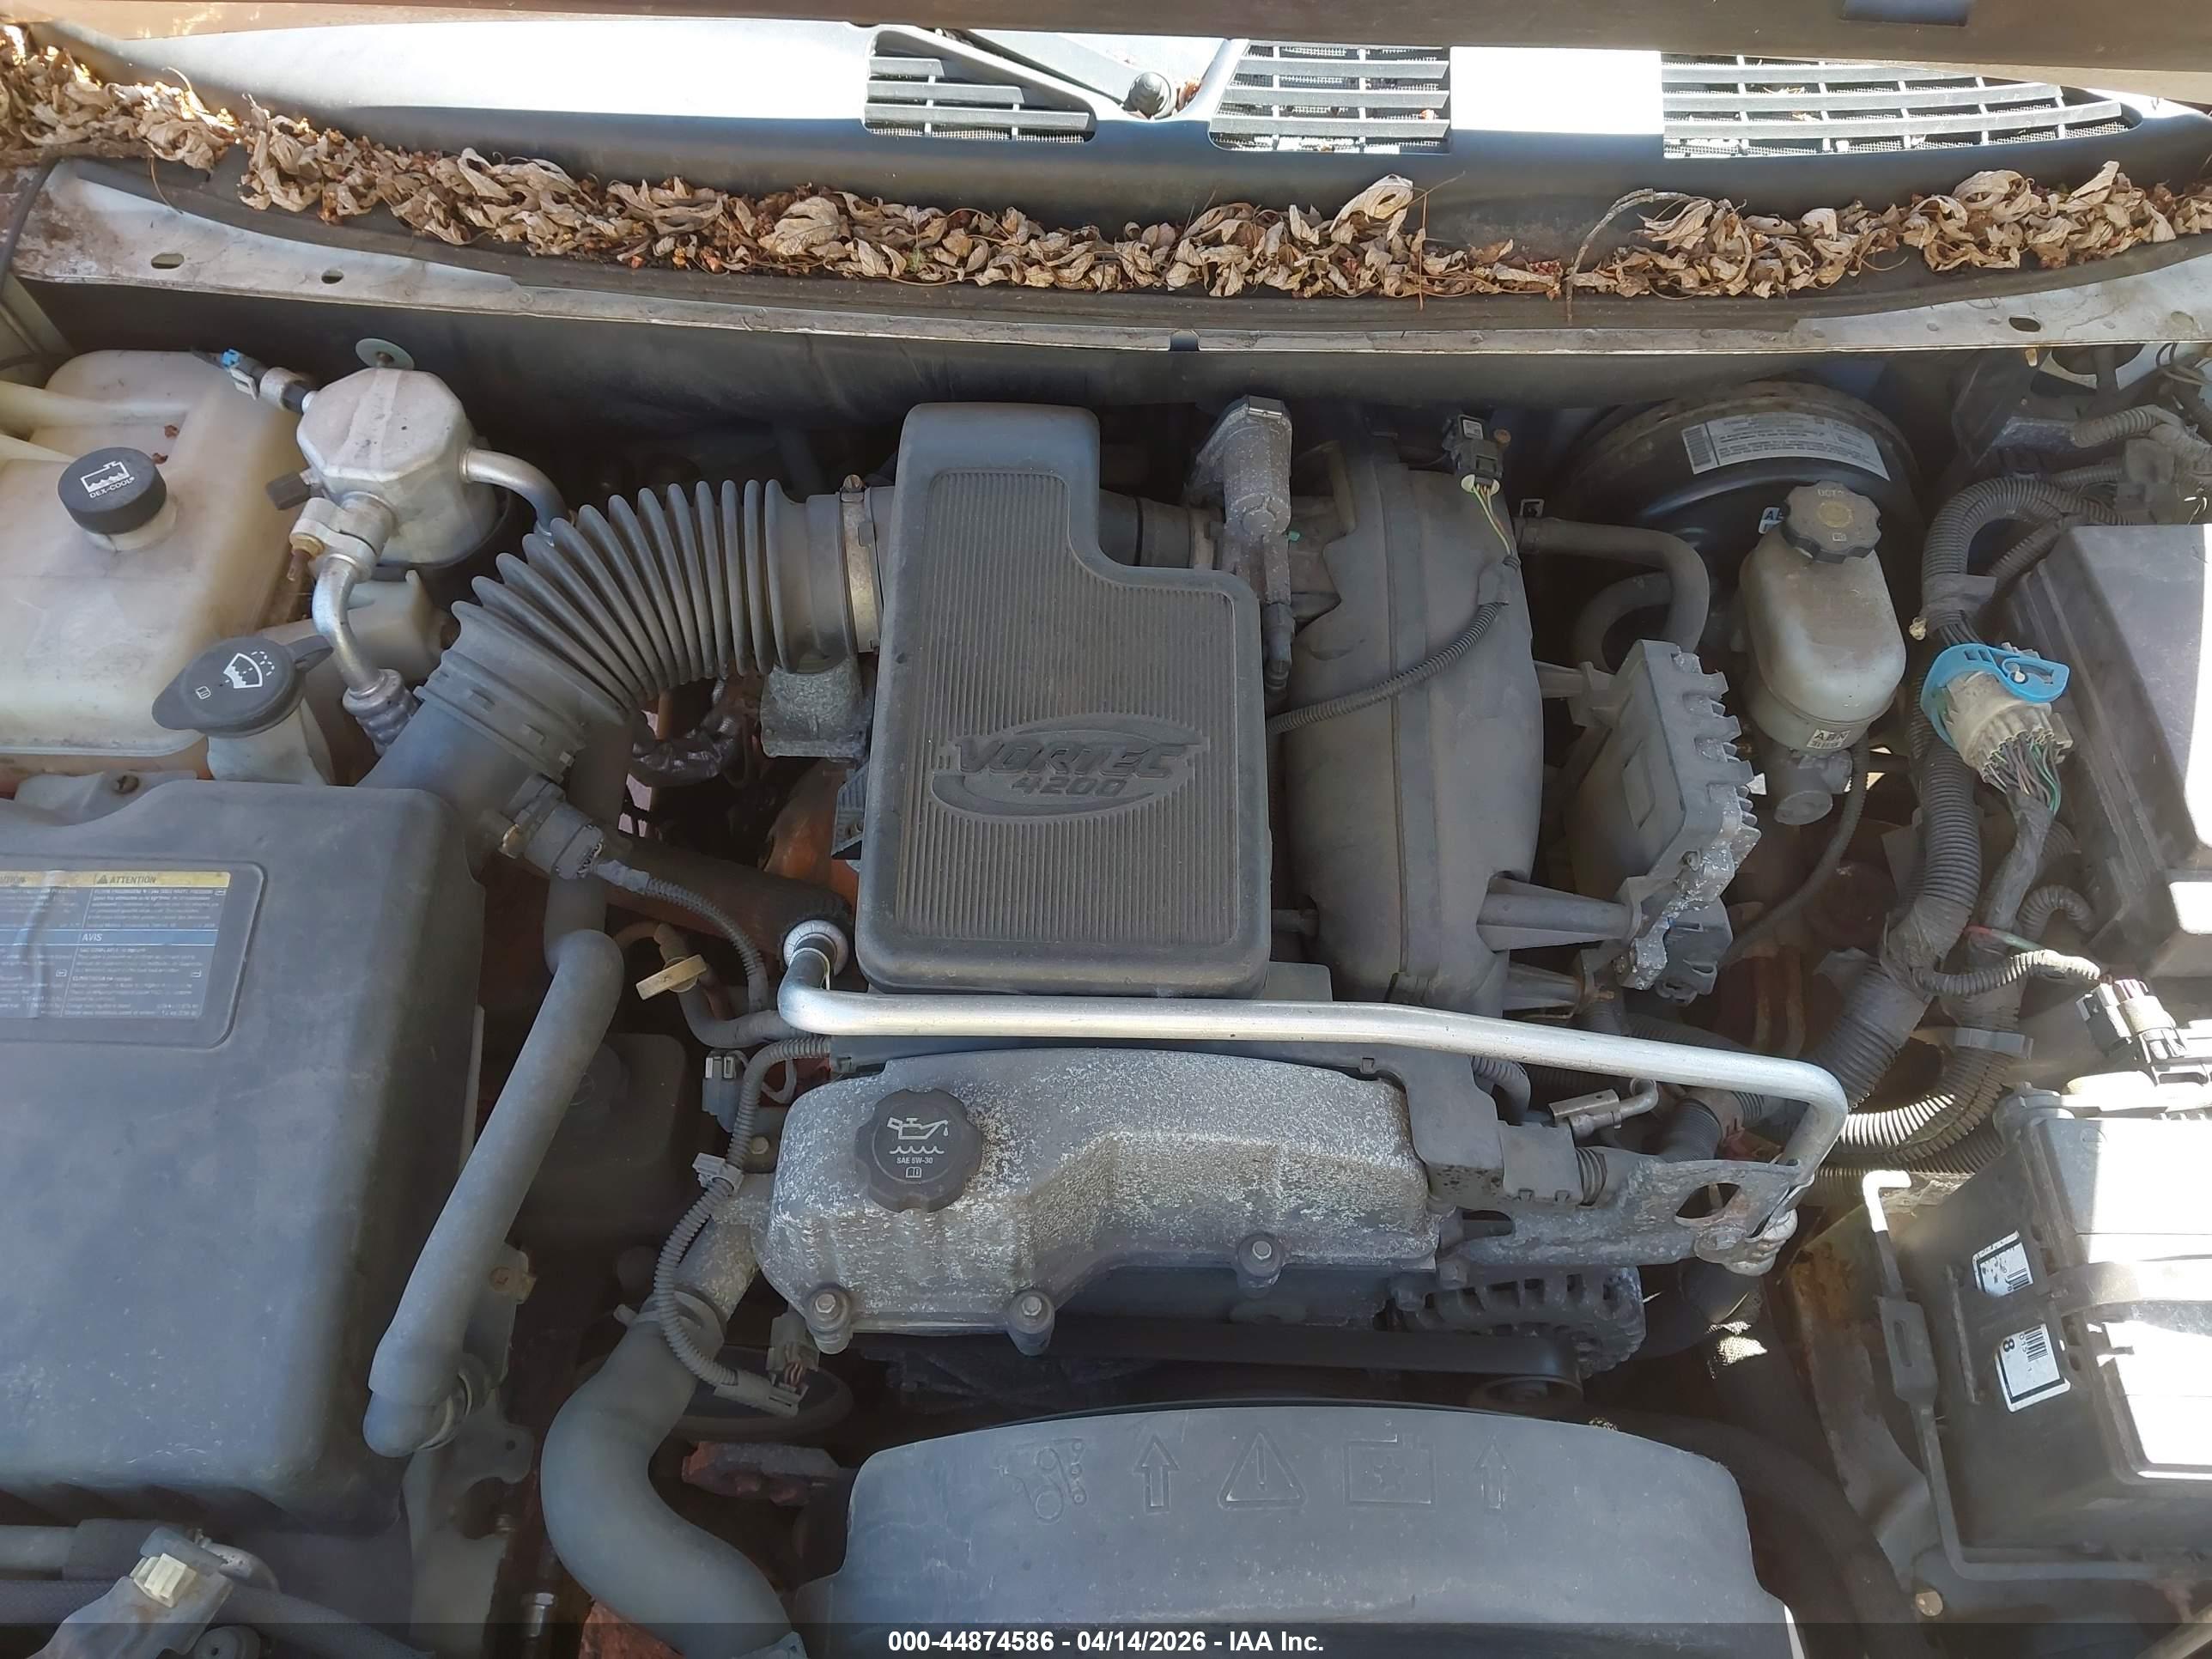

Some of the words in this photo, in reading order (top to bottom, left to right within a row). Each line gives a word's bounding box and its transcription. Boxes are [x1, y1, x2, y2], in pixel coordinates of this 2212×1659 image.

[956, 738, 1190, 778] VORTEC
[1012, 776, 1127, 797] 4200
[109, 875, 157, 884] ATTENTION
[82, 933, 102, 942] AVIS
